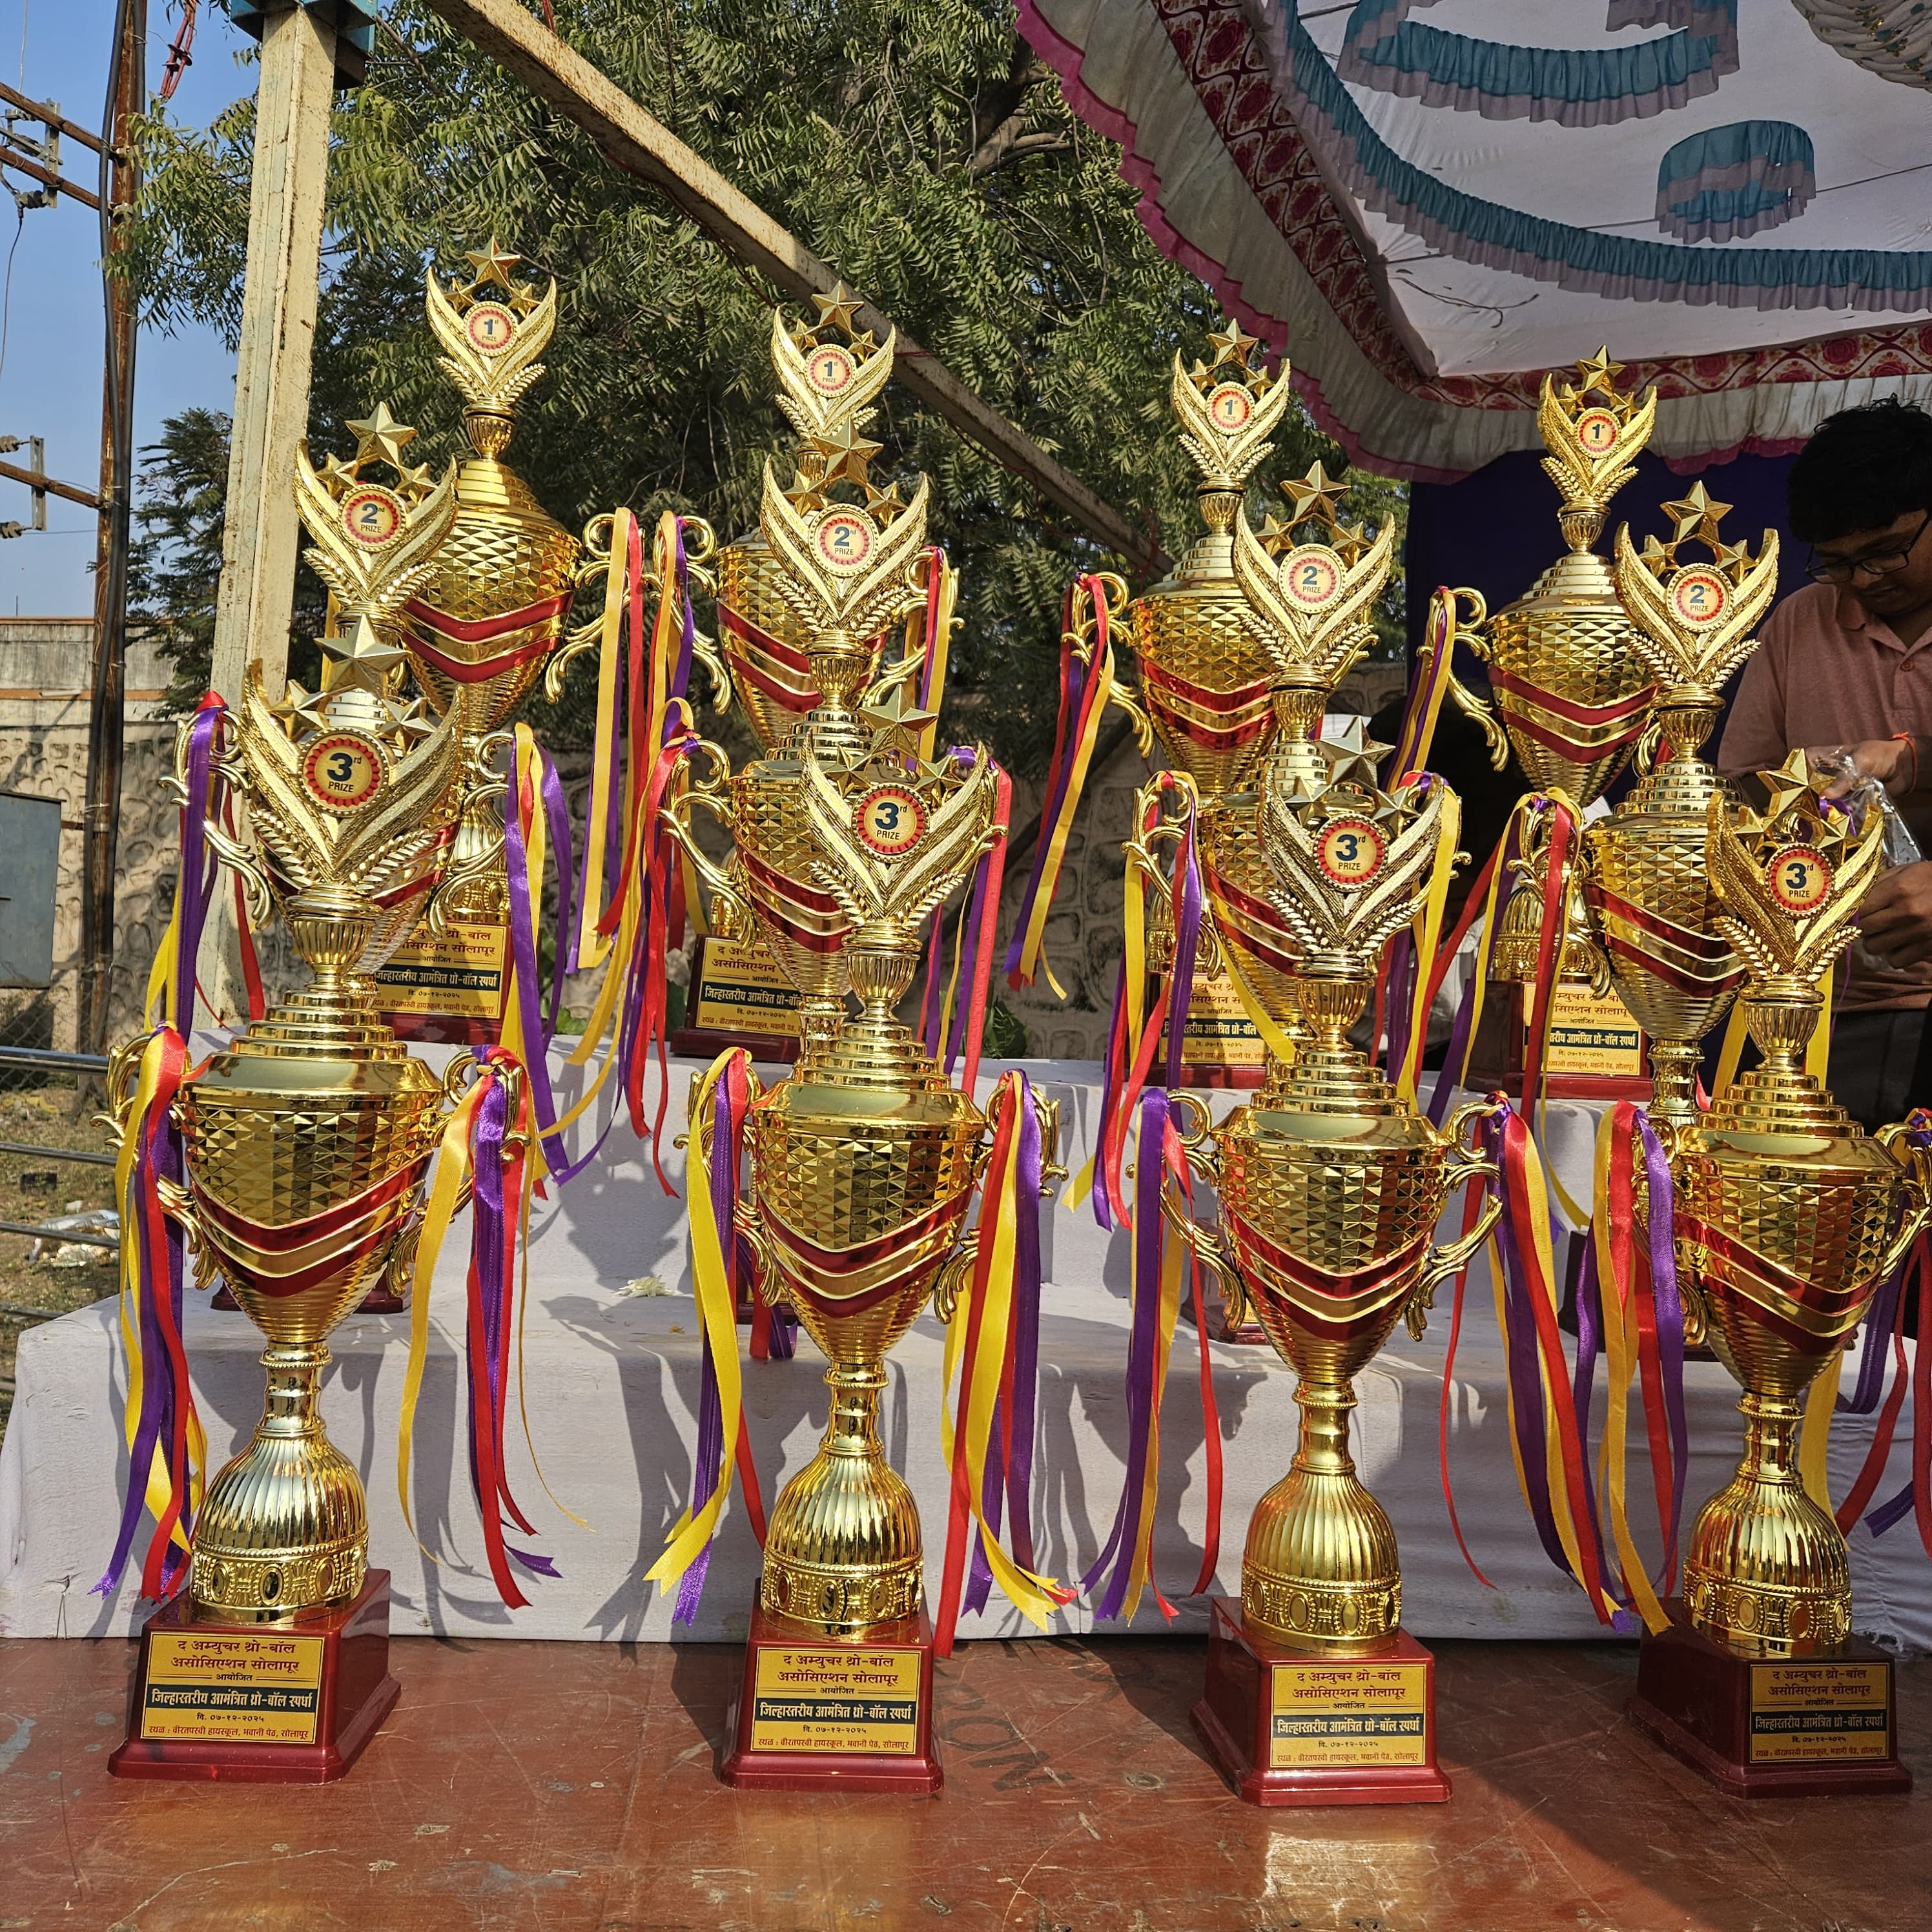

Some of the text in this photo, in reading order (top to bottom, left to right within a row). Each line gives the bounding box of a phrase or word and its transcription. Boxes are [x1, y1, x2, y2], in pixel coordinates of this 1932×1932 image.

[360, 524, 382, 533] PRIZE
[834, 526, 856, 547] 2nd
[1302, 566, 1324, 585] 2nd
[1689, 585, 1711, 604] 2nd
[327, 752, 362, 782] 3rd
[328, 781, 354, 792] PRIZE
[875, 803, 907, 830] 3rd
[876, 830, 899, 840] PRIZE
[1335, 834, 1366, 861] 3rd
[1338, 862, 1361, 870] PRIZE
[1786, 863, 1813, 889] 3rd
[446, 928, 491, 940] थ्रो-बॉल
[401, 939, 495, 956] सिएशन सोलापूर
[718, 945, 726, 954] द
[423, 954, 452, 963] आयोजित
[712, 958, 776, 972] असोसिएशन
[418, 969, 448, 984] आमंत्रित
[479, 974, 498, 987] स्पर्धा
[752, 974, 779, 984] आयोजित
[1193, 981, 1222, 993] म्युचर
[705, 985, 746, 1001] जिल्हास्तरीय
[747, 989, 776, 1004] आमंत्रित
[1189, 992, 1228, 1006] सिएशन
[1556, 992, 1585, 1002] म्युचर
[444, 1003, 460, 1011] भवानी
[1554, 1003, 1627, 1017] सिएशन सोलापू
[178, 1639, 296, 1655] द अम्युचर थ्रो-बॉल
[171, 1654, 300, 1674] असोसिएशन सोलापूर
[783, 1654, 895, 1669] द अम्युचर थ्रो-बॉल
[216, 1672, 253, 1681] आयोजित
[777, 1669, 899, 1687] असोसिएशन सोलापूर
[1297, 1669, 1402, 1685] द अम्युचर थ्रो-बॉल
[820, 1685, 855, 1694] आयोजित
[1292, 1685, 1406, 1700] असोसिएशन सोलापूर
[151, 1688, 313, 1708] जिल्हास्तरीय आमंत्रित थ्रो-बॉल स्पर्धा
[759, 1701, 912, 1720] जिल्हास्तरीय आमंत्रित थ्रो-बॉल स्पर्धा
[1333, 1701, 1366, 1710] आयोजित
[197, 1712, 207, 1720] दि.
[172, 1725, 207, 1735] वीरतपस्वी
[208, 1728, 241, 1738] हायस्कूल,
[243, 1727, 265, 1736] भवानी
[266, 1728, 279, 1738] पेठ,
[281, 1729, 309, 1740] सोलापूर
[803, 1724, 812, 1732] दि.
[1277, 1719, 1328, 1735] जिल्हास्तरीय
[1330, 1717, 1363, 1732] आमंत्रित
[1399, 1716, 1420, 1732] स्पर्धा
[781, 1737, 812, 1747] वीरतपस्वी
[814, 1740, 845, 1749] हायस्कूल,
[847, 1739, 867, 1747] भवानी
[868, 1740, 881, 1749] पेठ,
[883, 1740, 909, 1751] सोलापूर
[1361, 1752, 1379, 1761] भवानी
[1394, 1752, 1419, 1762] सोलापूर
